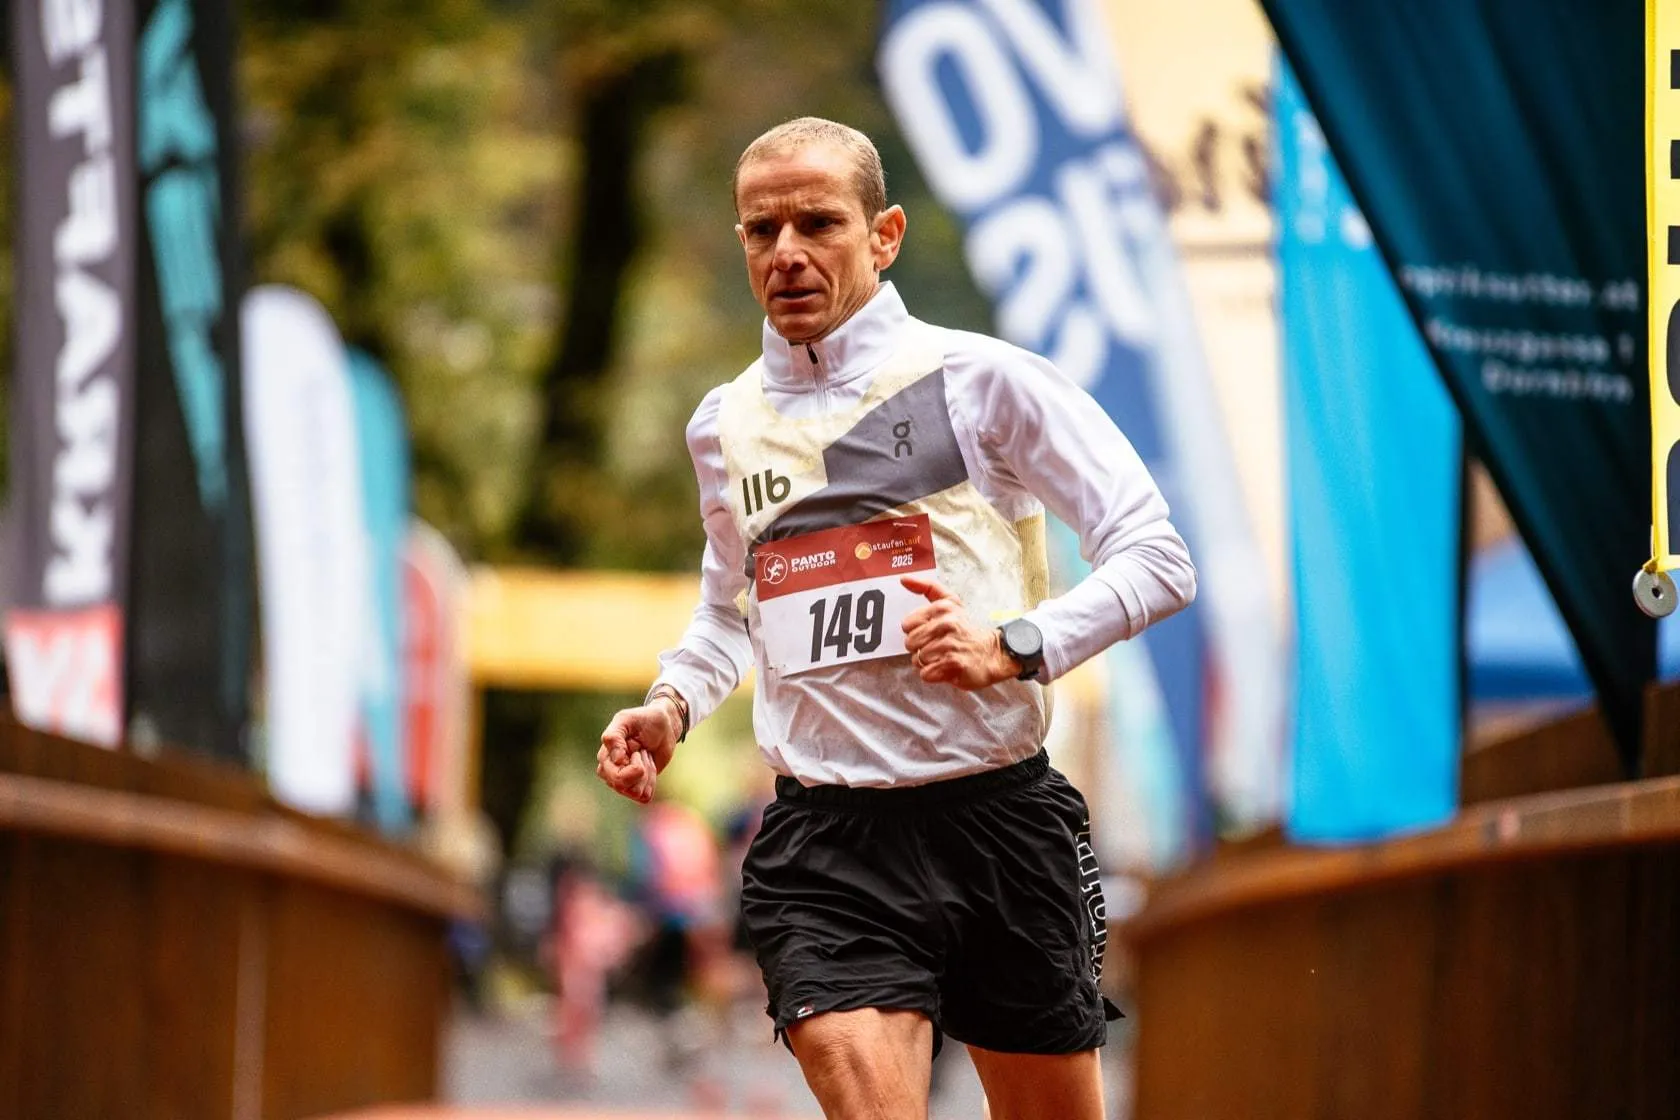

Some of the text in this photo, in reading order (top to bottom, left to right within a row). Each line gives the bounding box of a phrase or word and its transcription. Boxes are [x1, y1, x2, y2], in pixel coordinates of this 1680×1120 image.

[791, 550, 835, 567] PANTO
[791, 559, 836, 573] OUTDOOR
[891, 554, 913, 568] 2025
[809, 589, 885, 664] 149
